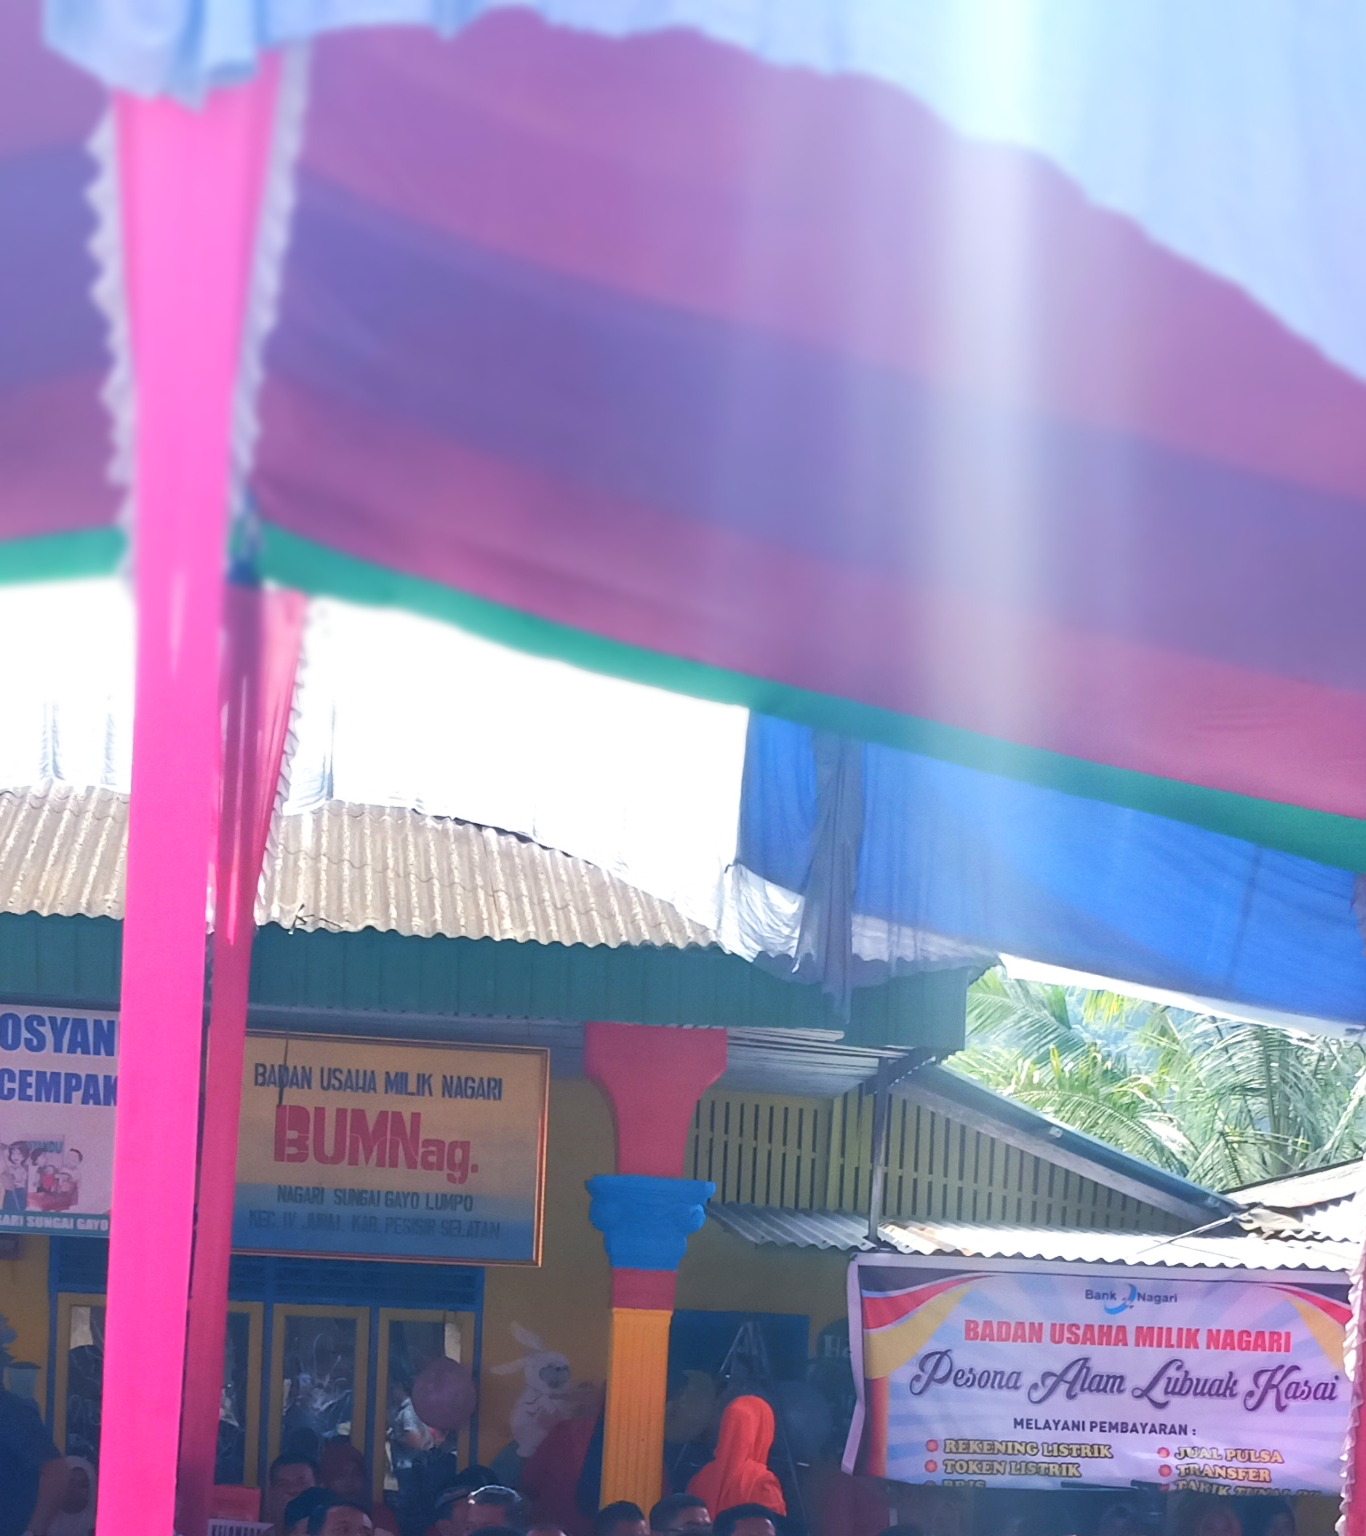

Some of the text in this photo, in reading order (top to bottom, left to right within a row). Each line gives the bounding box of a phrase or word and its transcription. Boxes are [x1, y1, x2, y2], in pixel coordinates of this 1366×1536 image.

[254, 1063, 503, 1100] BADAN USAHA MILIK NAGARI
[274, 1104, 479, 1184] BUMNag.
[277, 1185, 473, 1212] NAGARI SUNGAI GAYO LUMPO
[27, 1217, 73, 1229] SUNGAI
[76, 1219, 109, 1231] GAYO
[385, 1217, 435, 1236] PESISIR
[440, 1219, 500, 1239] SELATAN
[1085, 1289, 1177, 1305] Bank Nagari
[964, 1319, 1291, 1353] BADAN USAHA MILIK NAGARI
[909, 1349, 1339, 1412] Pesona Alam Lubuak Kasai
[1013, 1417, 1085, 1433] MELAYANI
[1089, 1420, 1187, 1436] PEMBAYARAN
[943, 1438, 1113, 1459] REKENING LISTRIK
[1174, 1446, 1284, 1464] JUAL PULSA
[943, 1459, 1082, 1478] TOKEN LISTRIK
[1176, 1463, 1272, 1482] TRANSFER
